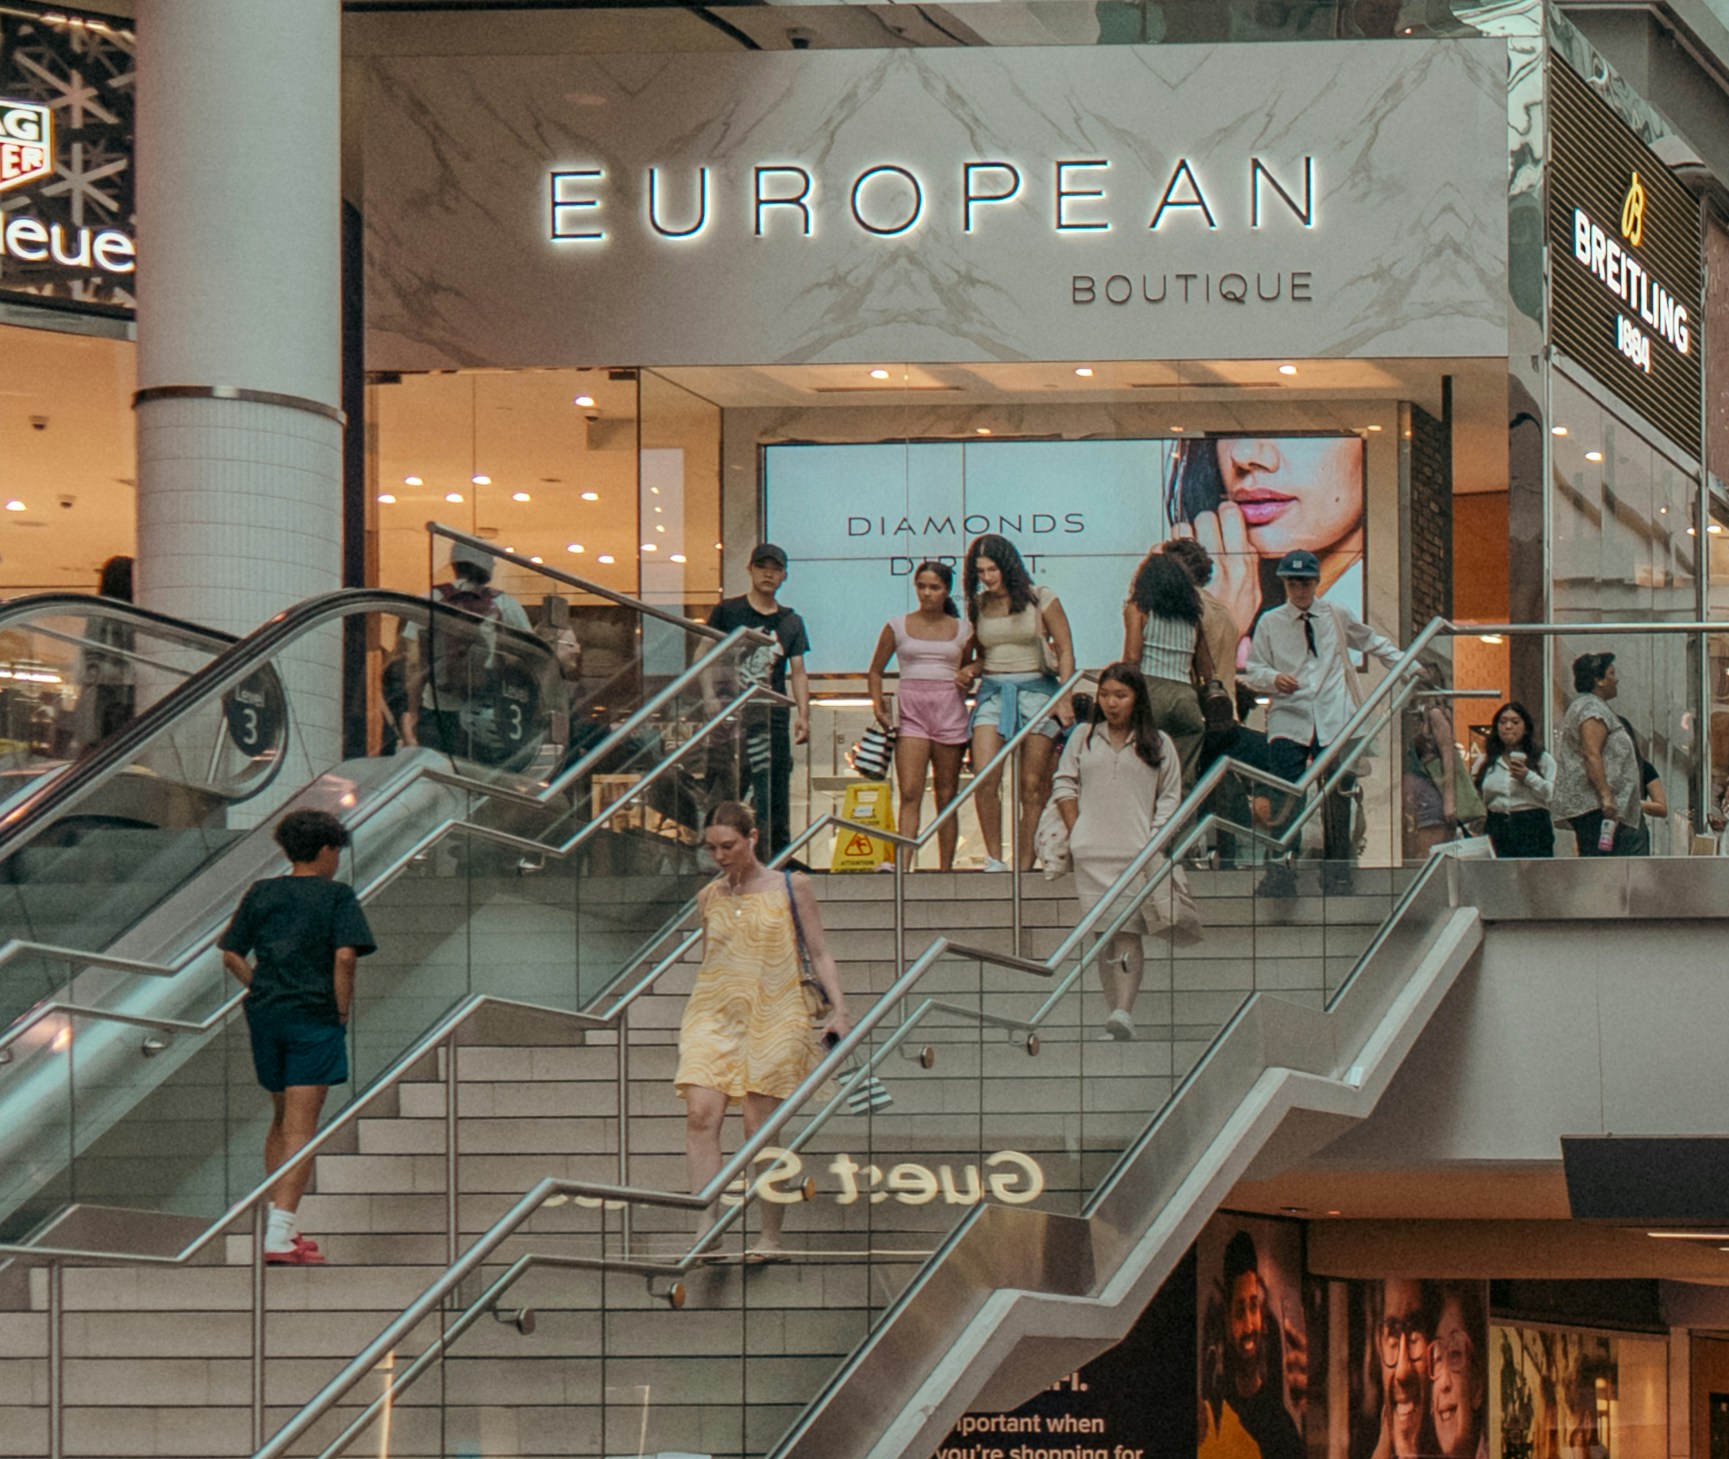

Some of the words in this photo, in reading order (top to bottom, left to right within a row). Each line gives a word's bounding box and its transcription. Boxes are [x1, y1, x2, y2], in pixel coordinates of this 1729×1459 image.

[547, 154, 1317, 242] EUROPEAN
[0, 210, 136, 272] eue
[1071, 271, 1315, 306] BOUTIQUE
[1574, 208, 1691, 354] BREITLING
[1617, 314, 1652, 374] 1884
[846, 511, 1087, 537] DIAMONDS
[889, 554, 1045, 576] DRT
[243, 709, 258, 745] 3
[510, 704, 523, 740] 3
[950, 1413, 1041, 1437] portant
[1045, 1413, 1105, 1433] when
